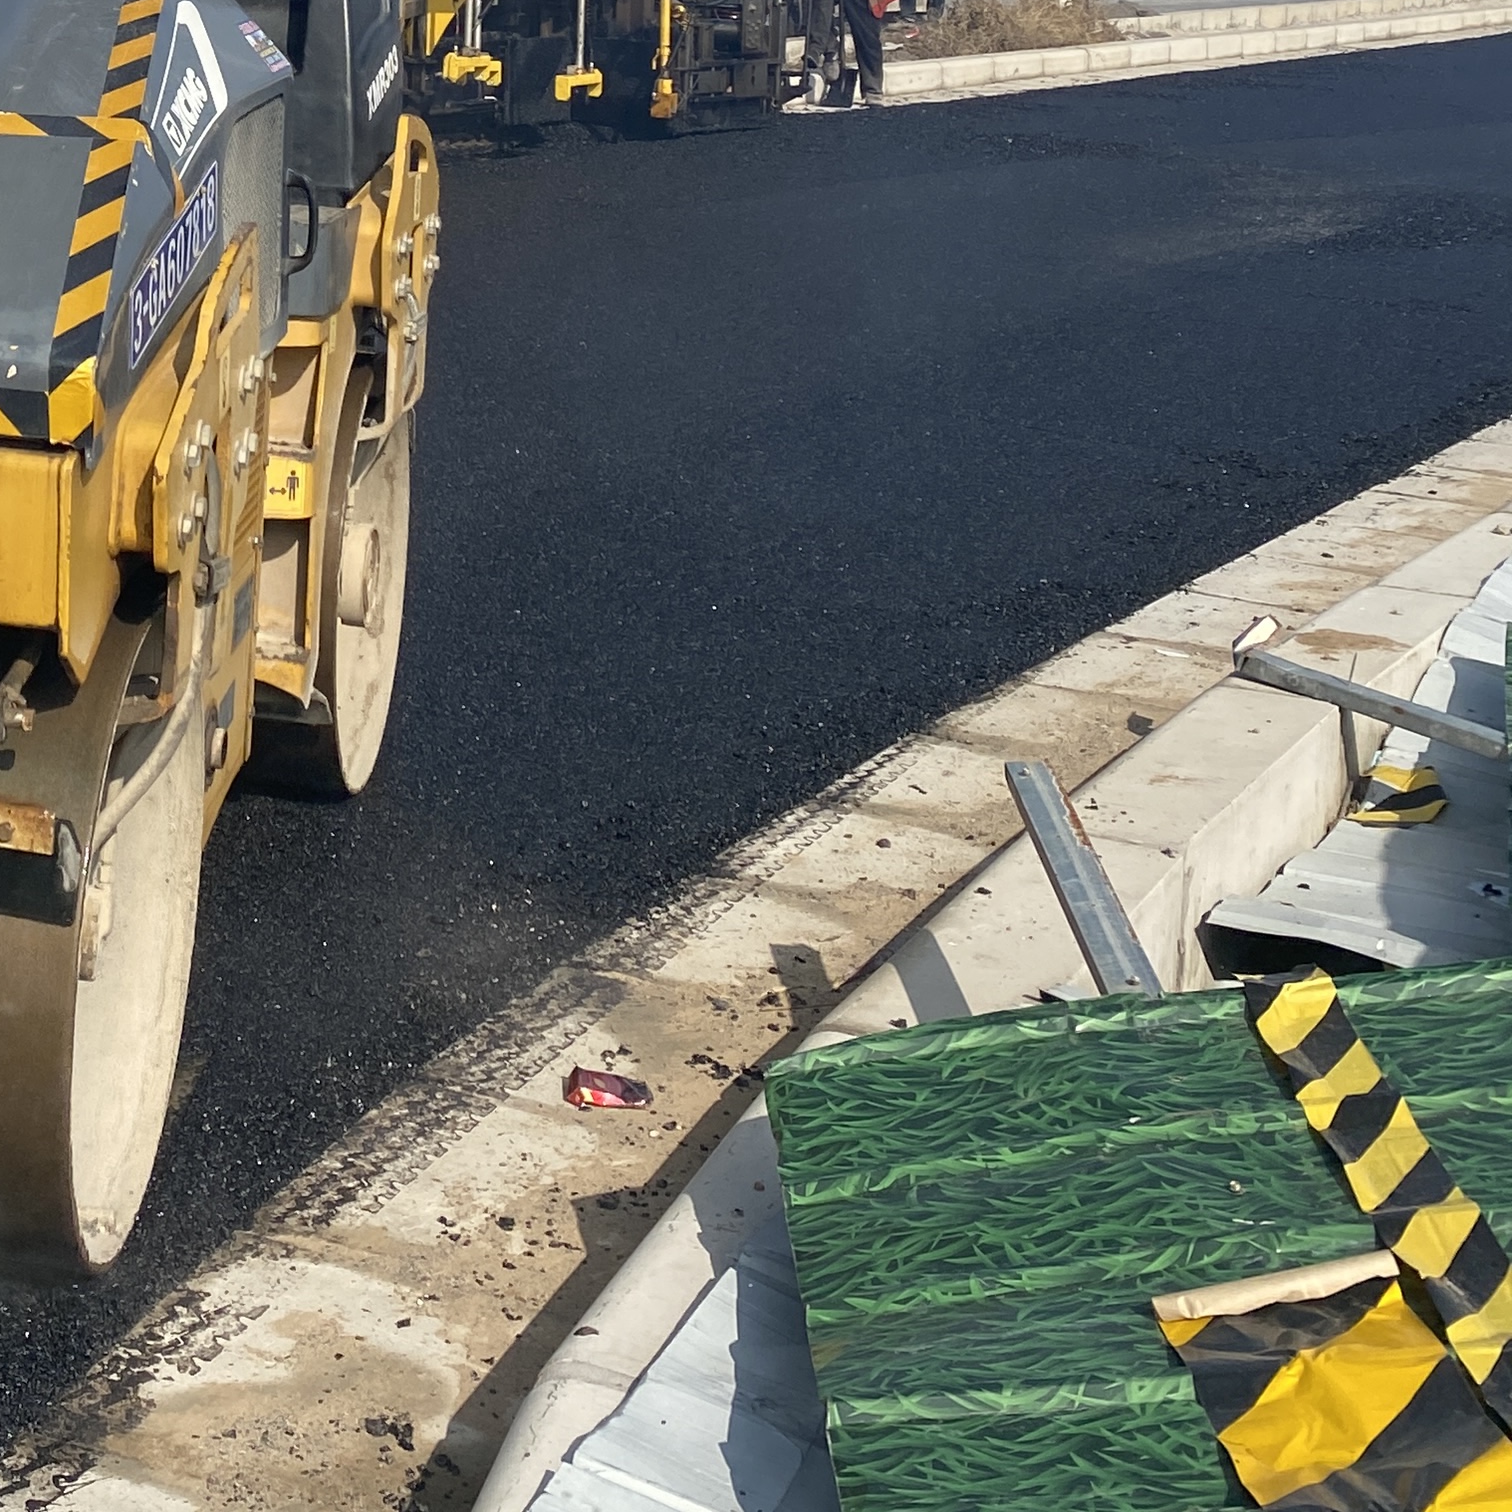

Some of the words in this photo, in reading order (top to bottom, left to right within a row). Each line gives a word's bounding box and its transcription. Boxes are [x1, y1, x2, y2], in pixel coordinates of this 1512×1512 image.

[170, 67, 209, 143] XCMG
[367, 44, 399, 122] XMR303
[134, 174, 216, 354] 3-GA607818
